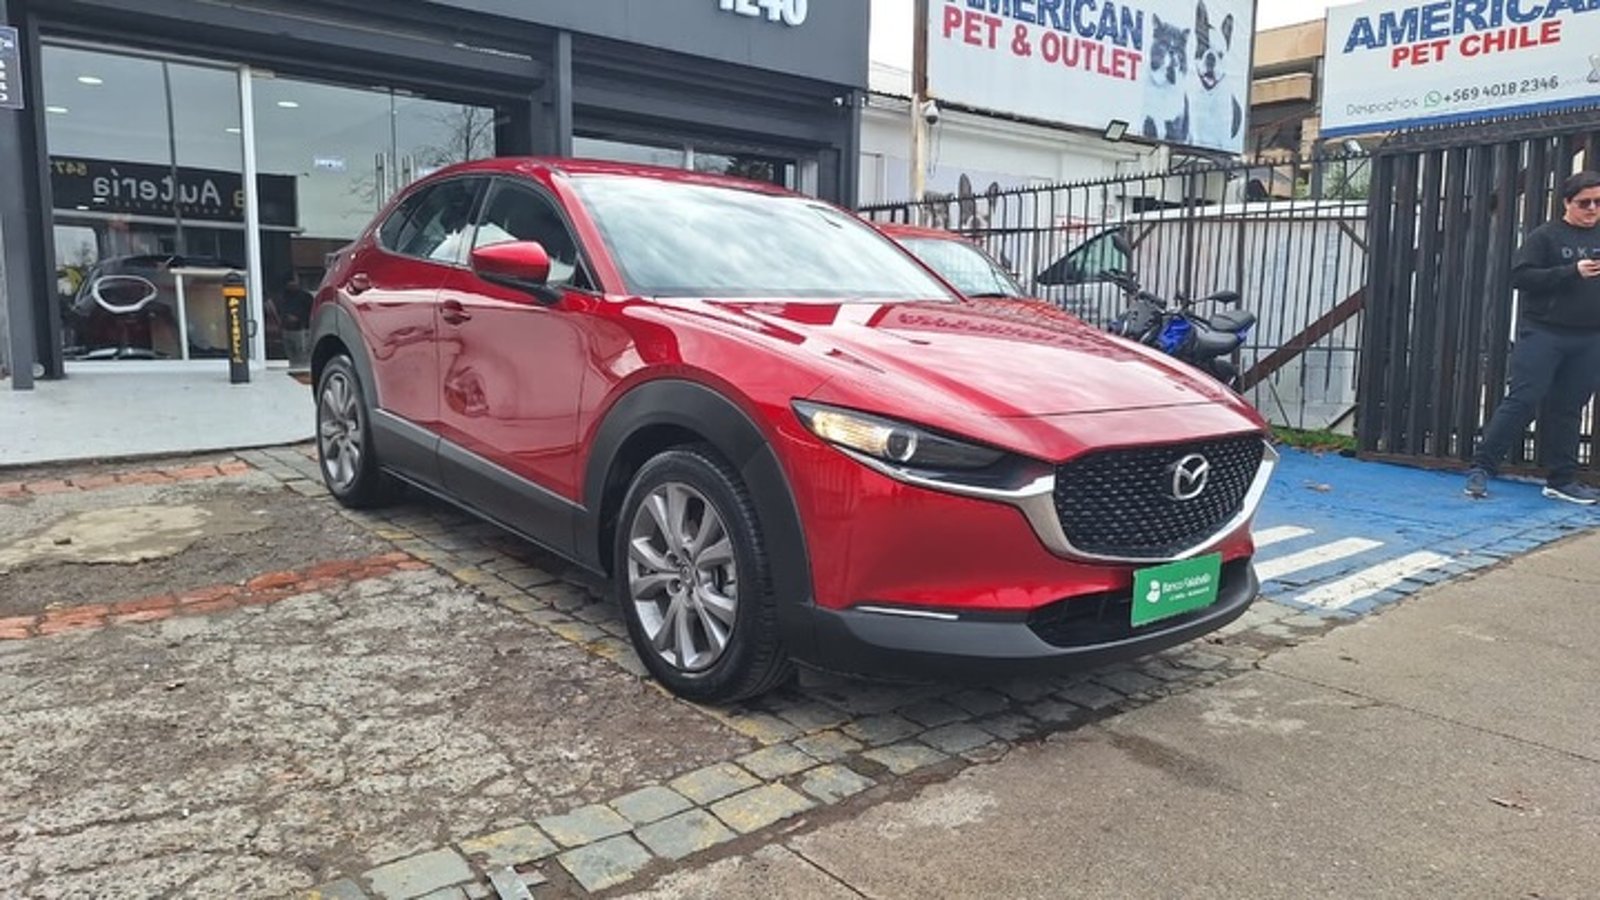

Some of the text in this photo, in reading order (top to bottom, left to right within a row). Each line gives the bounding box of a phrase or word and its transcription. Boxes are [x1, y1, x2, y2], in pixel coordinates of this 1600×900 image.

[944, 5, 1142, 80] PET & OUTLET
[1391, 20, 1562, 68] PET CHILE
[1444, 87, 1479, 102] +569
[1482, 82, 1517, 96] 4018
[1520, 75, 1559, 92] 2346
